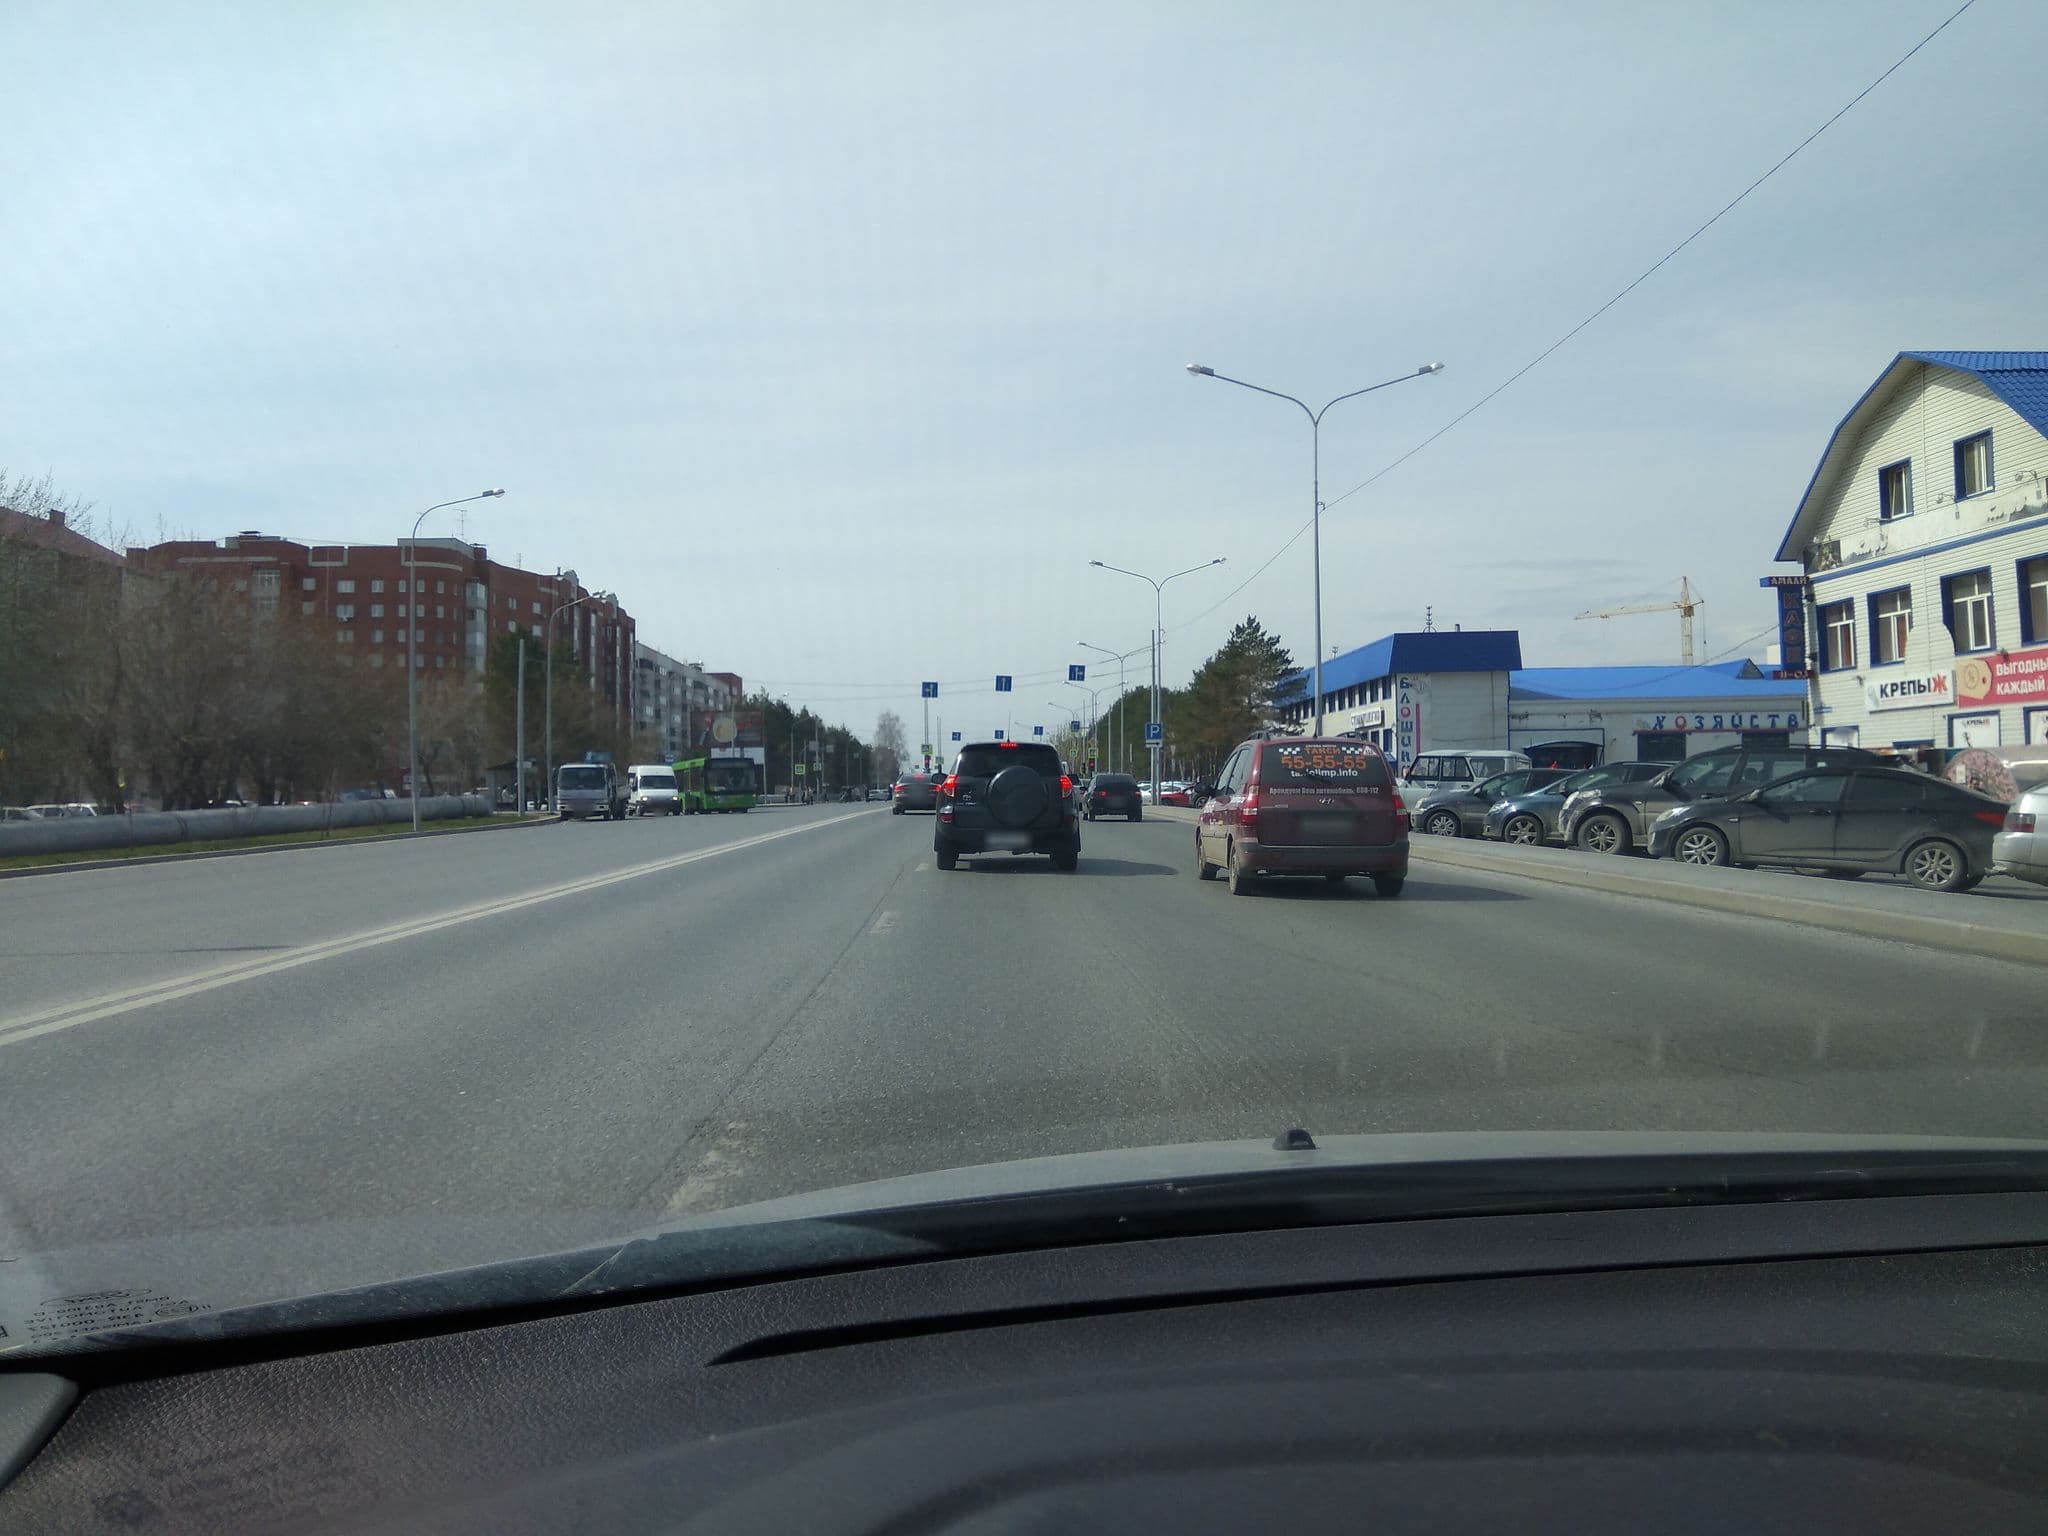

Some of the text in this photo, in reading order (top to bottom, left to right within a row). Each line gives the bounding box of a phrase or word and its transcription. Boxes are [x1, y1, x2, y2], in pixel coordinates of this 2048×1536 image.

[1880, 674, 1947, 698] КРЕПЫЖ
[1996, 675, 2045, 695] КАЖДЫЙ
[1304, 747, 1341, 755] ТАКСИ
[1281, 755, 1366, 769] 55-55-55
